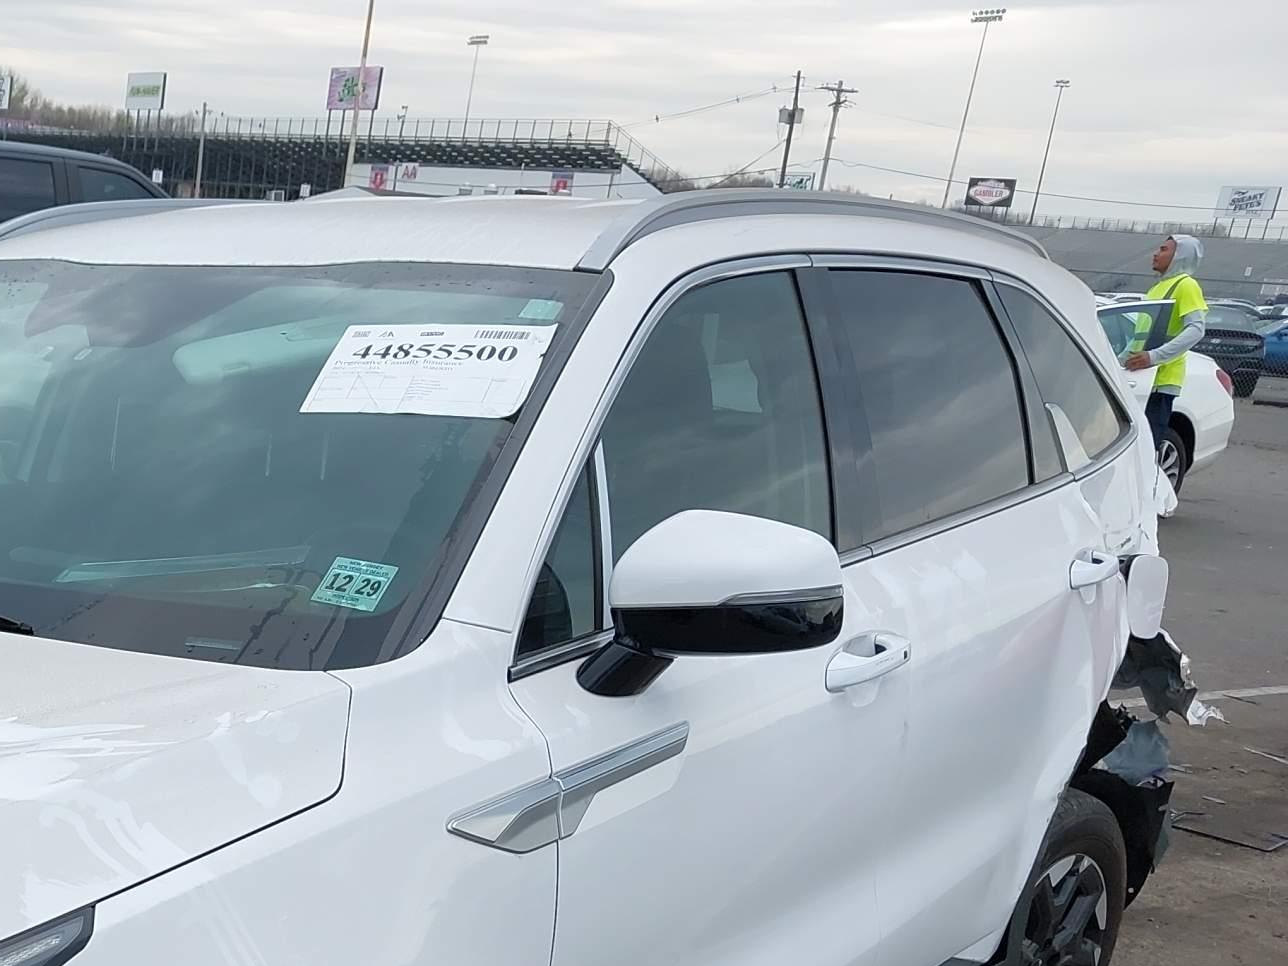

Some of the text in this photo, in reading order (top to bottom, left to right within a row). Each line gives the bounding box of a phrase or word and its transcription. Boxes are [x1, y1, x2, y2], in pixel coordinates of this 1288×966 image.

[1229, 192, 1265, 206] SNEAKY
[352, 343, 518, 362] 44855500
[325, 573, 382, 597] 12 29
